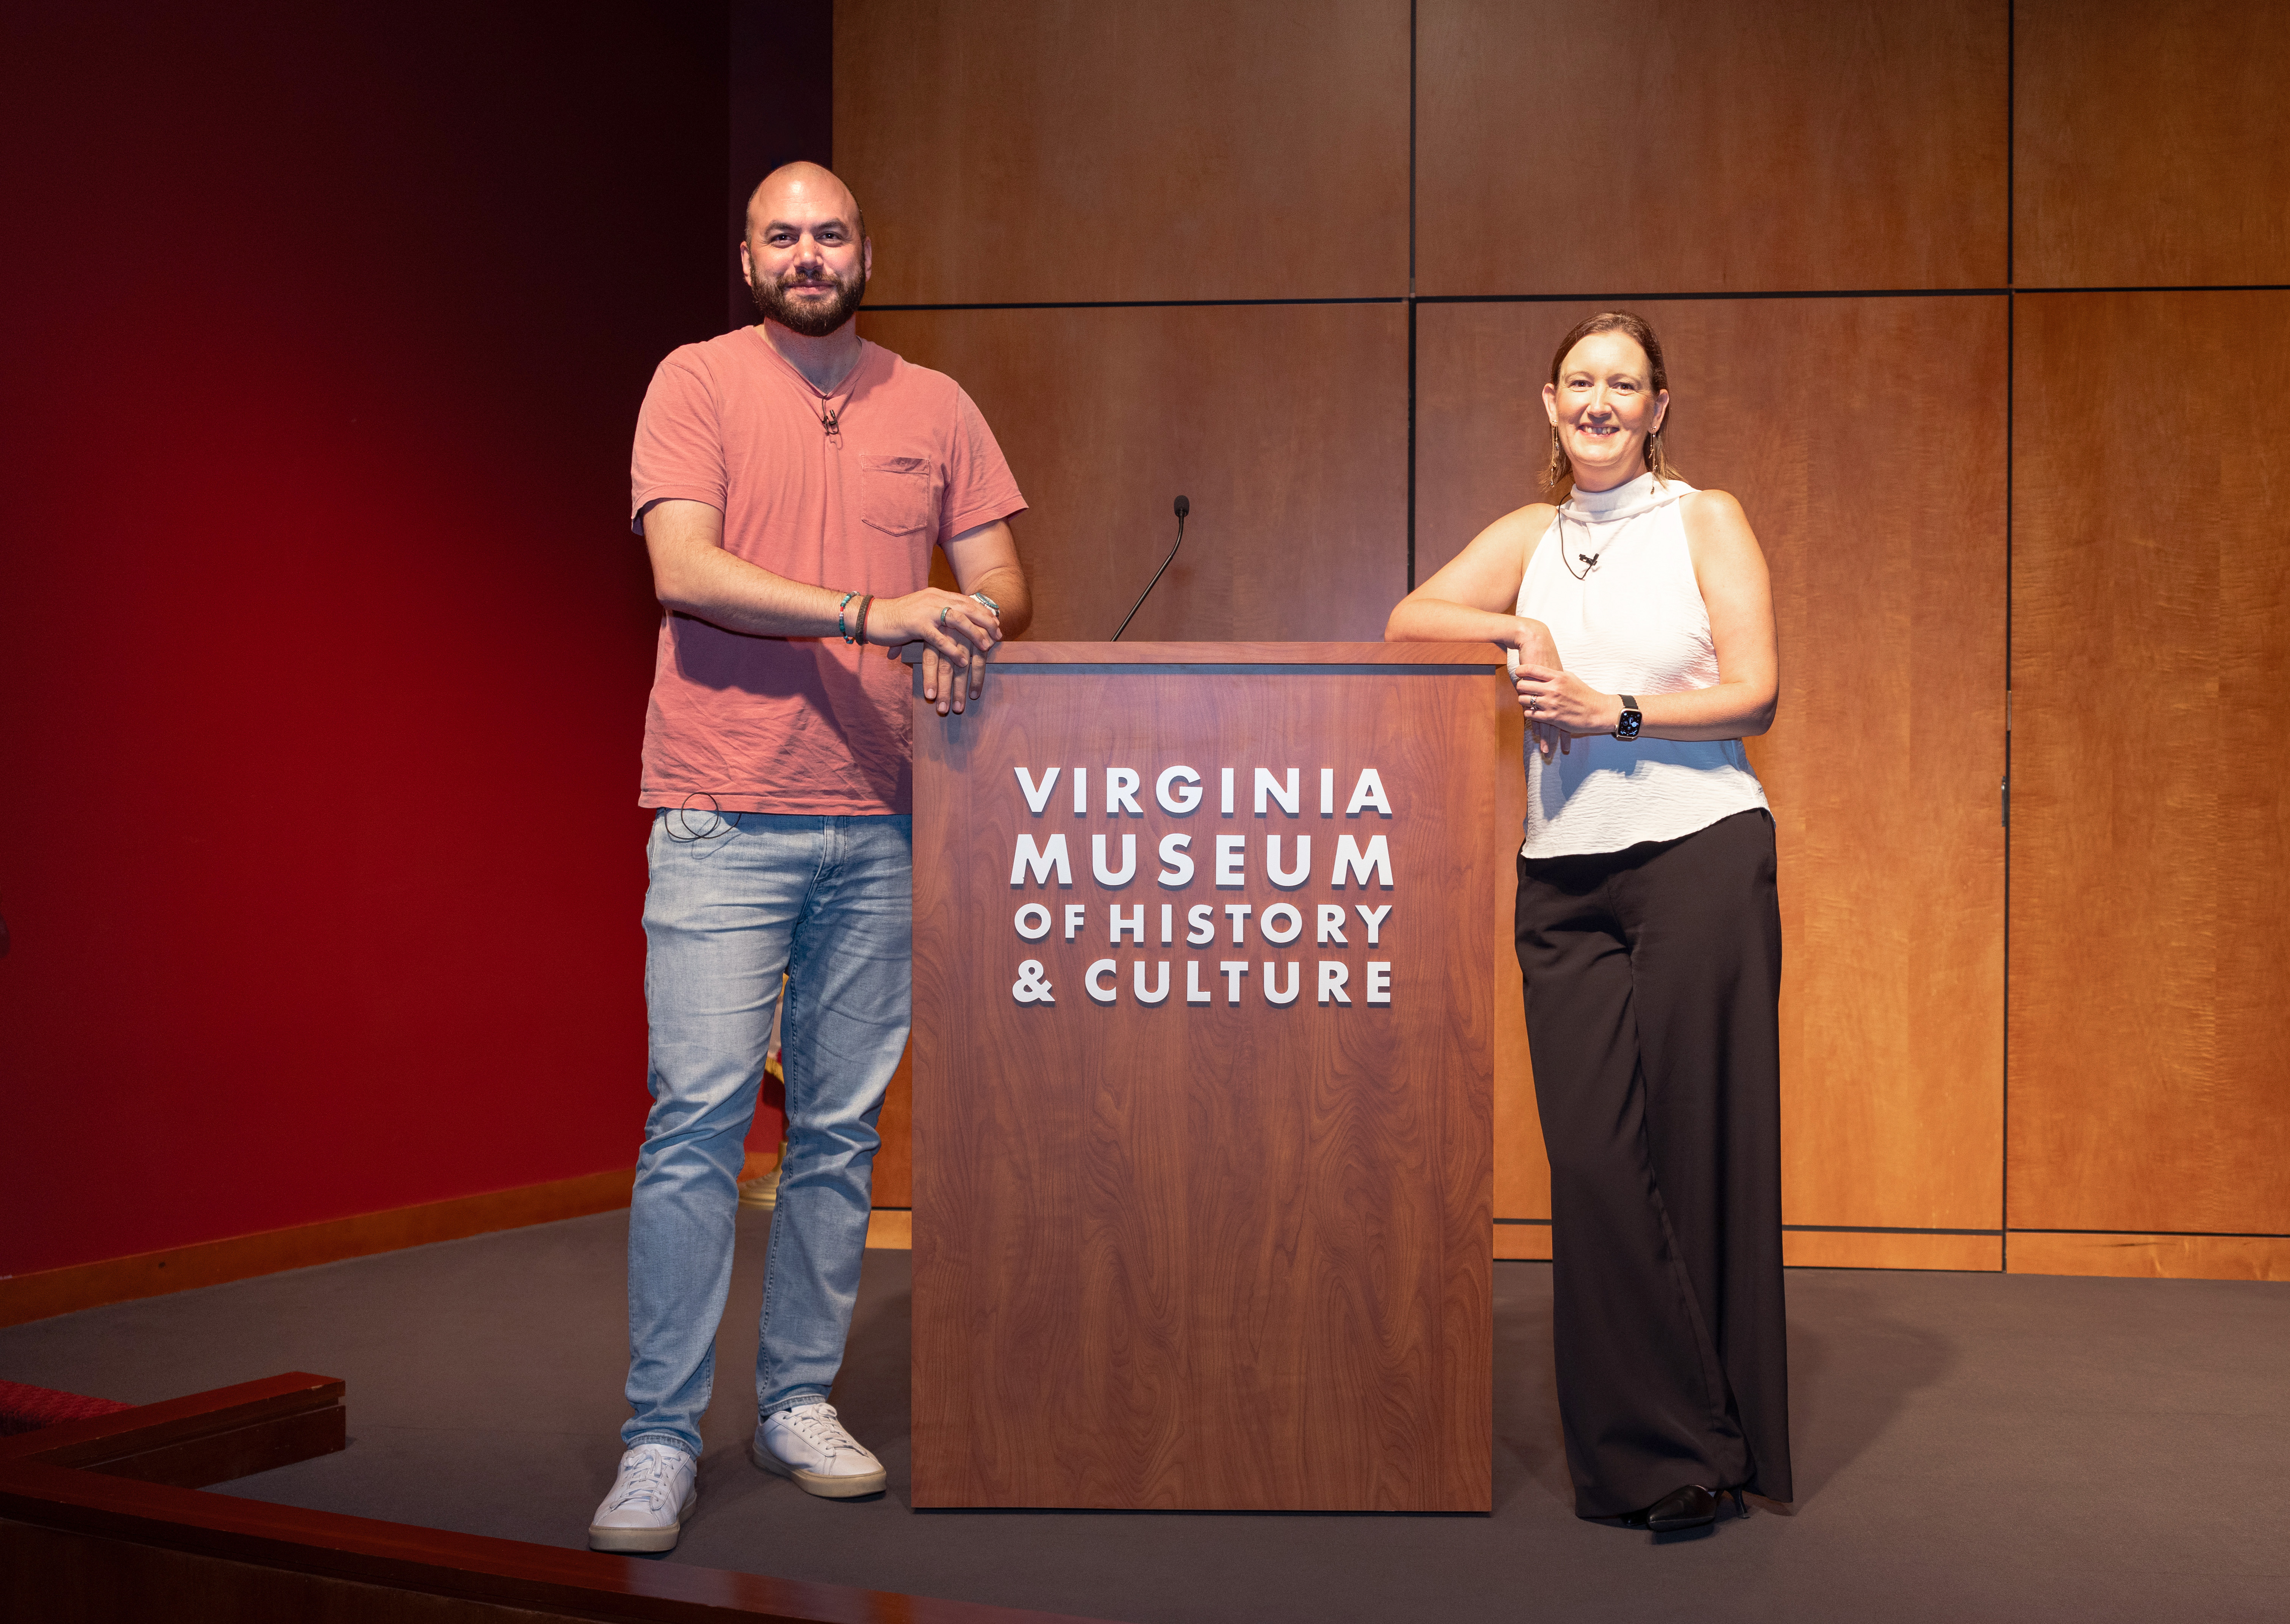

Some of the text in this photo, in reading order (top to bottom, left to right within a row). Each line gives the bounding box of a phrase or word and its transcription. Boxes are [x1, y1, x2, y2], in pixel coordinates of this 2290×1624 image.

[1014, 765, 1393, 814] VIRGINIA
[1010, 833, 1394, 886] MUSEUM
[1014, 903, 1392, 944] OF HISTORY
[1012, 959, 1391, 1004] & CULTURE
